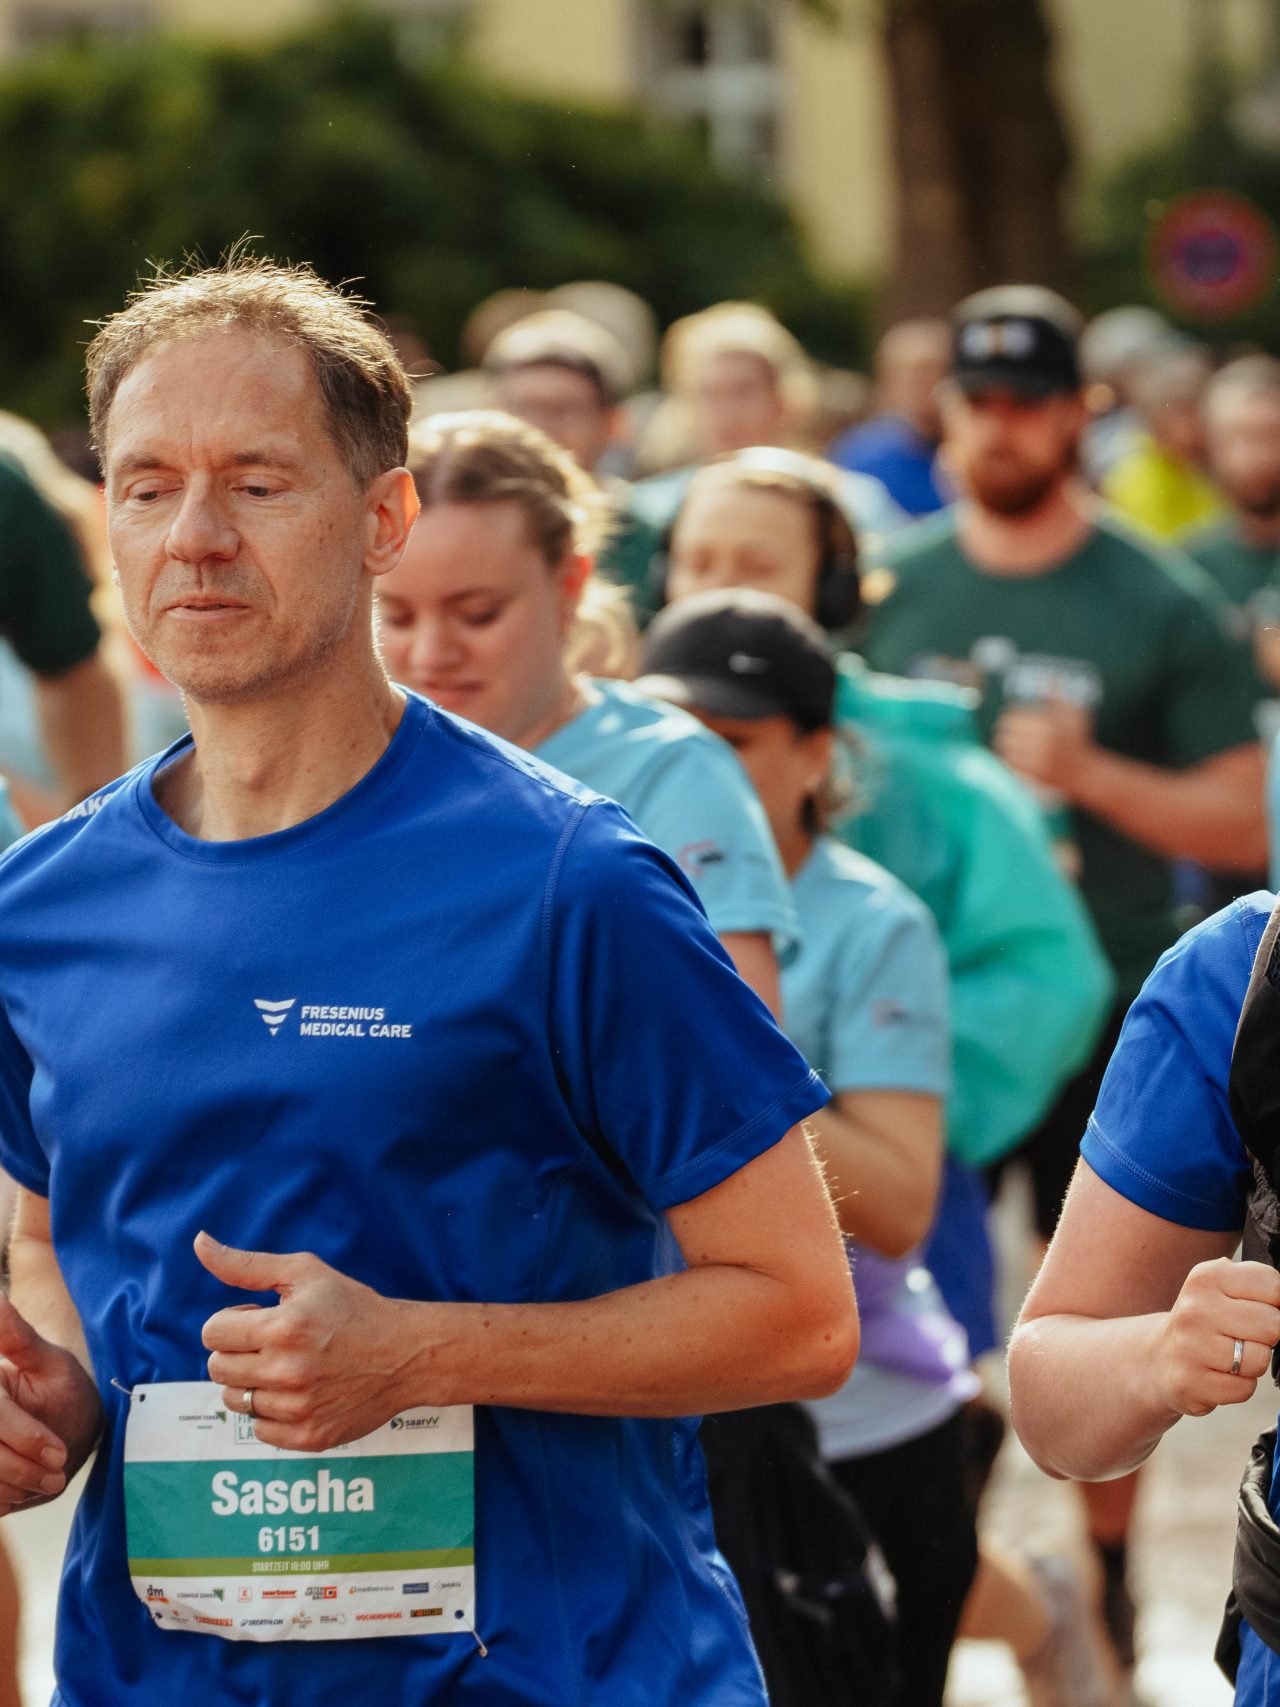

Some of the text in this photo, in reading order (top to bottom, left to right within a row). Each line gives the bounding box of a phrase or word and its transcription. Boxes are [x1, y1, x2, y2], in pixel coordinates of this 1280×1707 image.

[301, 1006, 385, 1020] FRESENIUS
[300, 1023, 412, 1038] MEDICAL CARE
[211, 1469, 374, 1516] Sascha
[258, 1525, 320, 1552] 6151
[252, 1561, 289, 1572] STARTZEIT
[312, 1560, 330, 1571] UHR
[147, 1585, 164, 1597] dm
